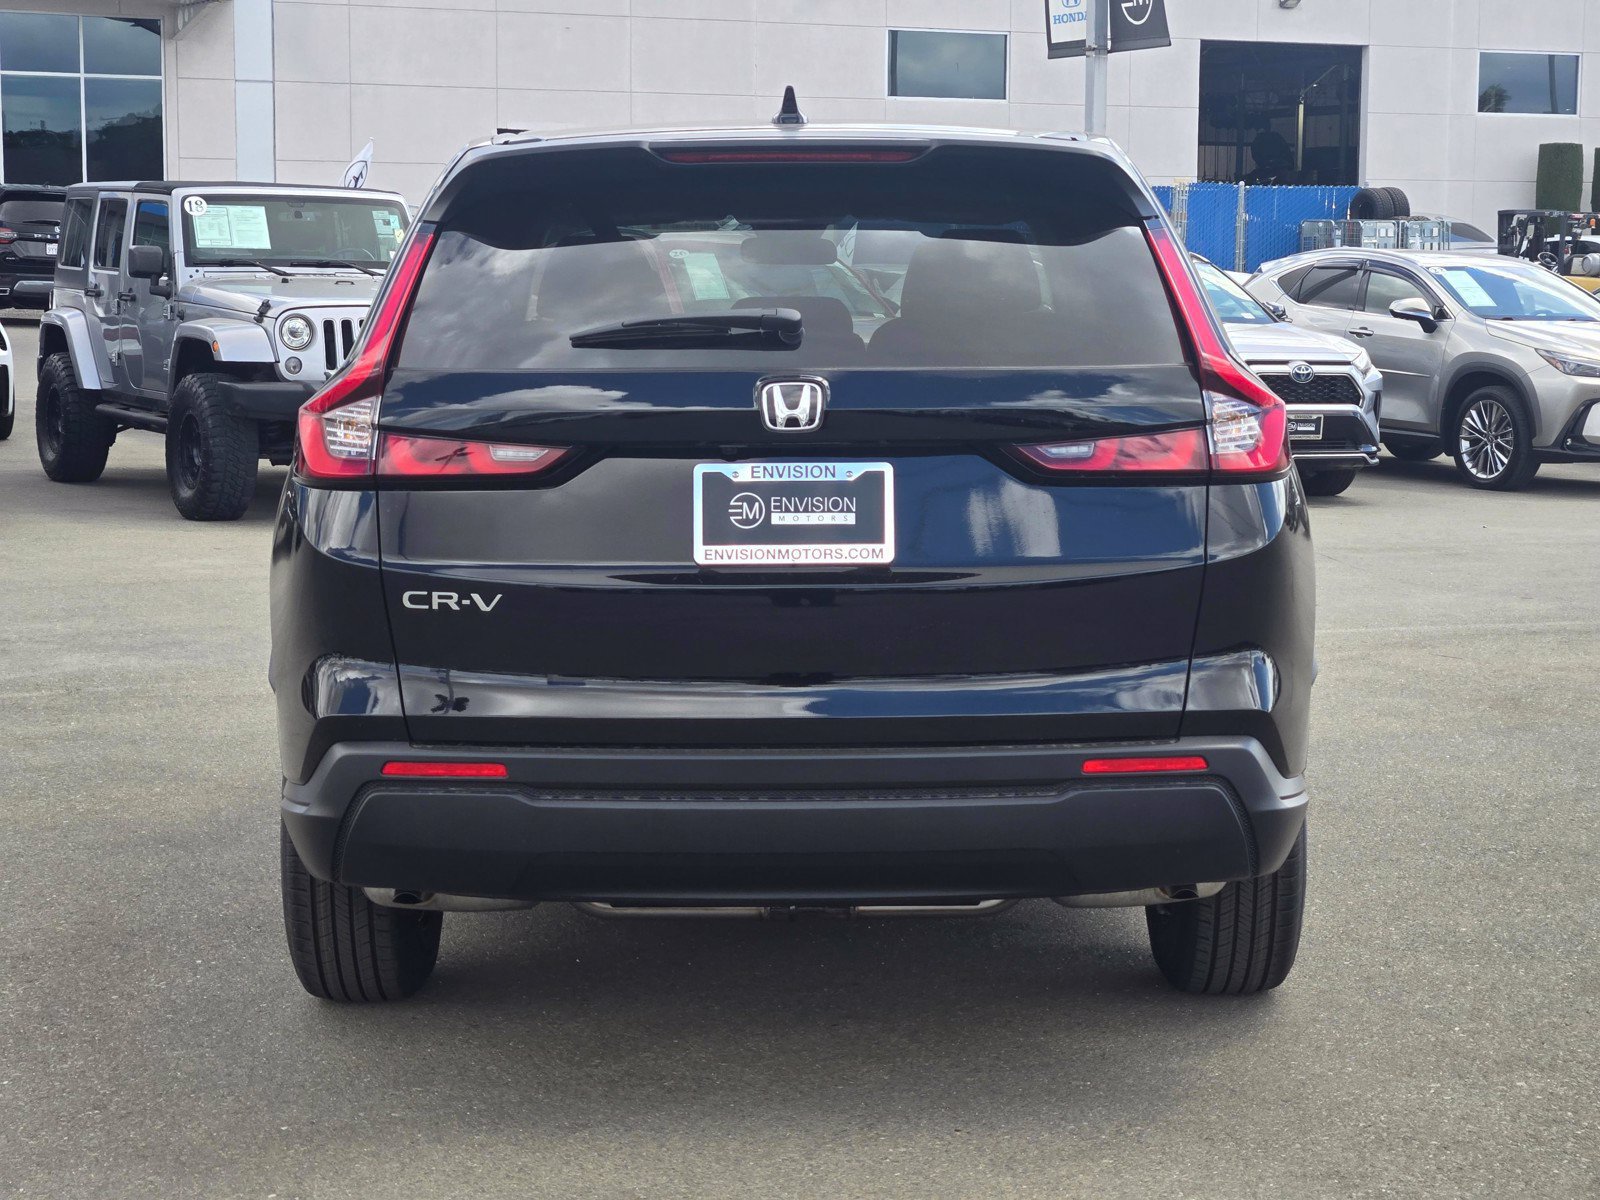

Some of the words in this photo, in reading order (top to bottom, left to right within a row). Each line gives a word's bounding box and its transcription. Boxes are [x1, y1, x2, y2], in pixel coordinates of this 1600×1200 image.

[187, 200, 204, 212] 18
[750, 465, 836, 479] ENVISION
[771, 496, 856, 512] ENVISION
[778, 514, 849, 522] MOTORS
[704, 547, 884, 561] ENVISIONMOTORS.COM
[402, 590, 503, 612] CR-V
